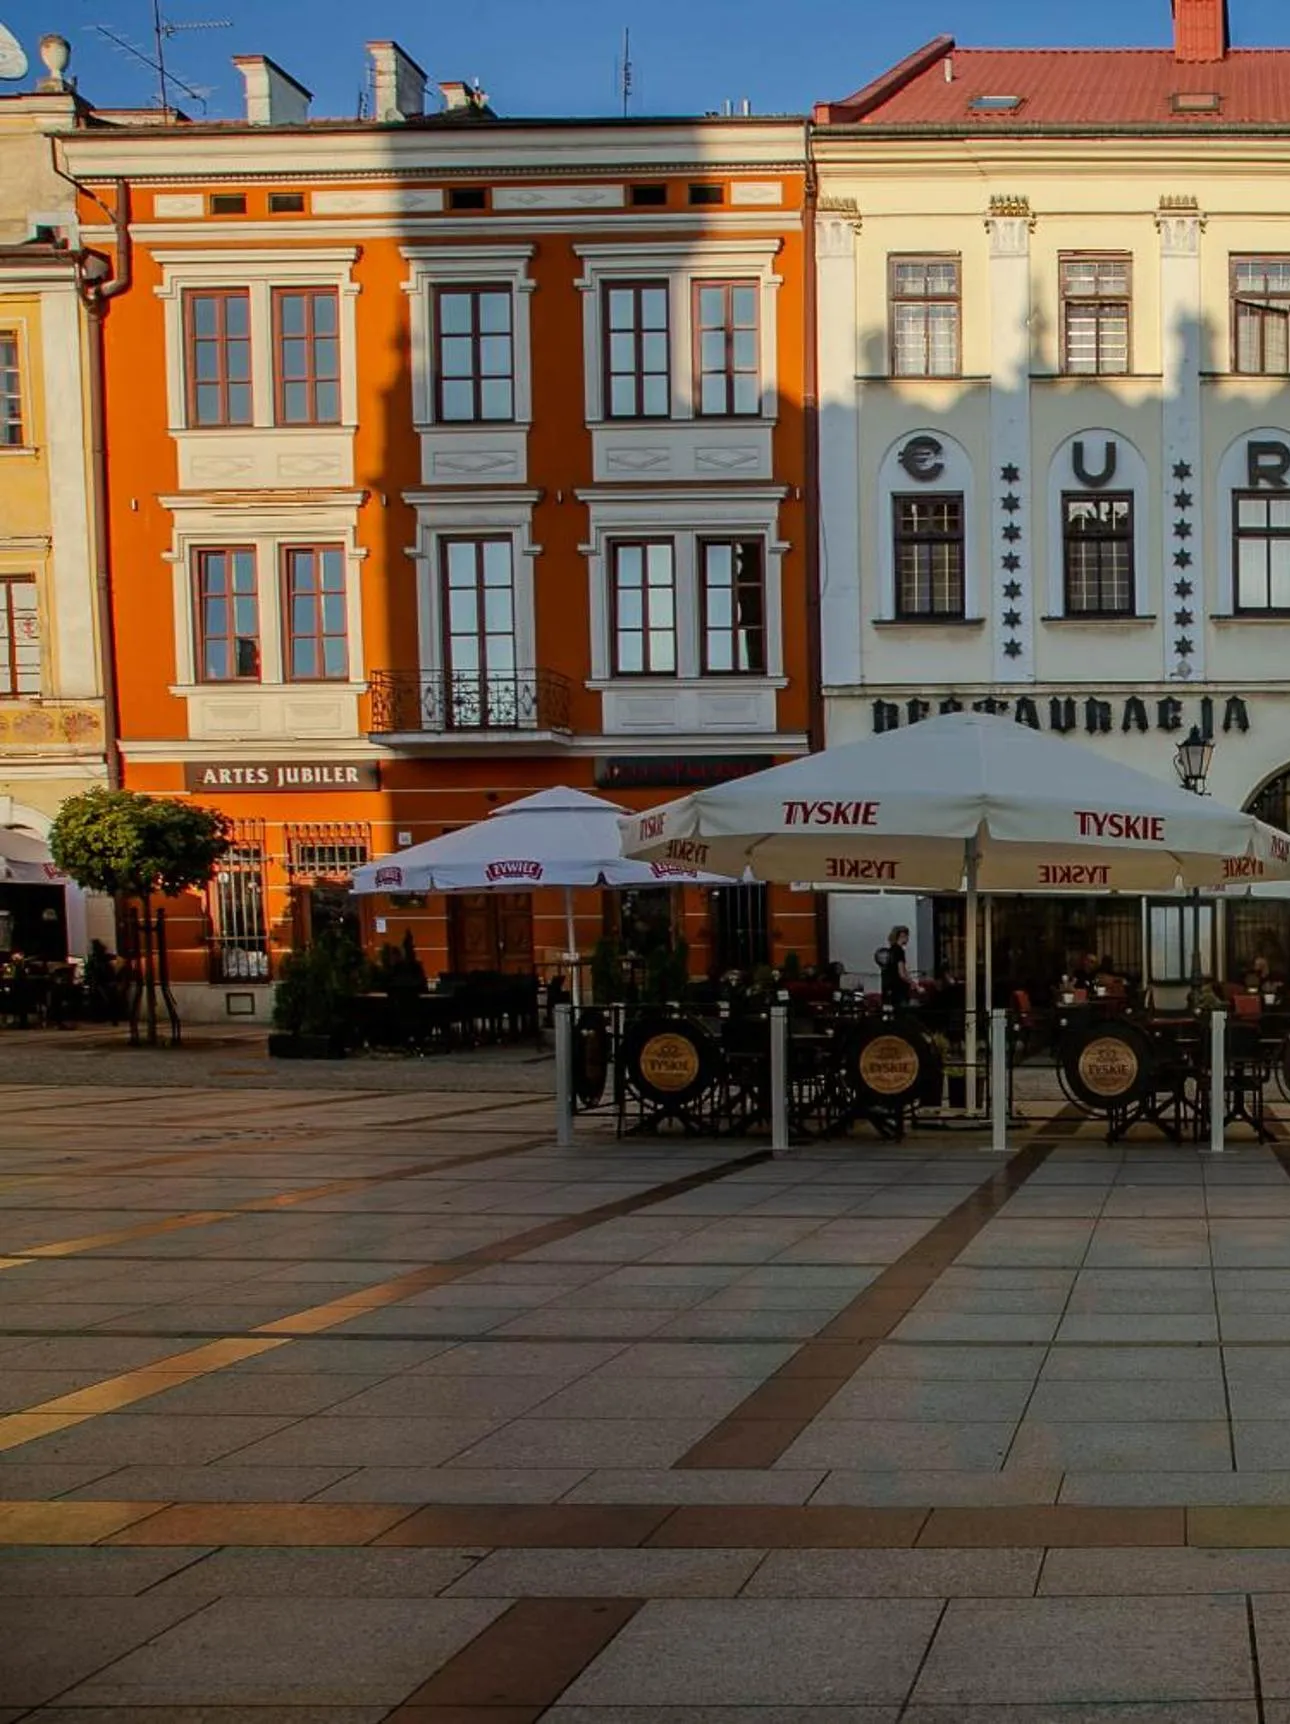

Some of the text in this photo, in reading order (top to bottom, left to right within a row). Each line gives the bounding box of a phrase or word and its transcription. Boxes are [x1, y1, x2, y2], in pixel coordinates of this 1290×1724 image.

[203, 767, 359, 787] ARTES JUBILER
[782, 801, 880, 826] TYSKIE
[1074, 811, 1166, 842] TYSKIE
